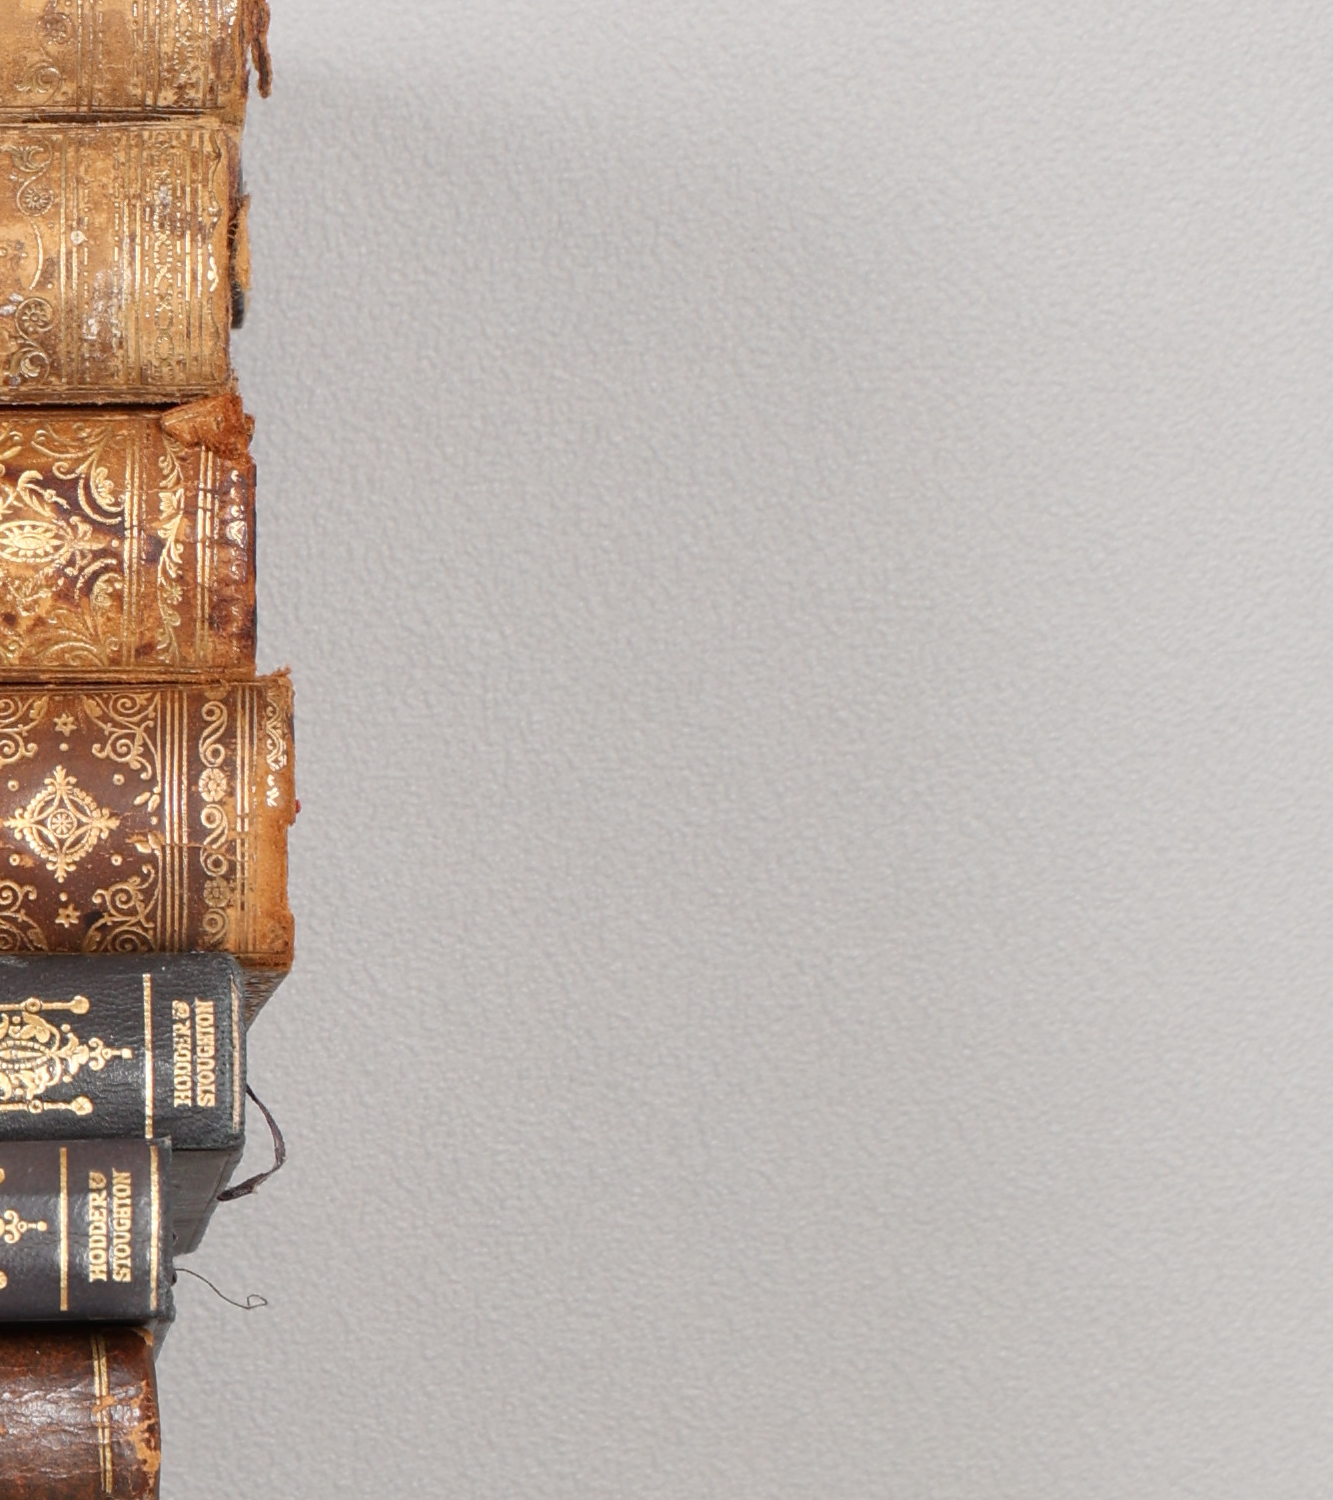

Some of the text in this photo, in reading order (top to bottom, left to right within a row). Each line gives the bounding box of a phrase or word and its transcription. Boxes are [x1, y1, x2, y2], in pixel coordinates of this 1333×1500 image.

[172, 1022, 193, 1107] HODDER
[195, 998, 215, 1108] STOUGHTON
[89, 1191, 107, 1282] HODDER
[111, 1168, 132, 1282] STOUGHTON
